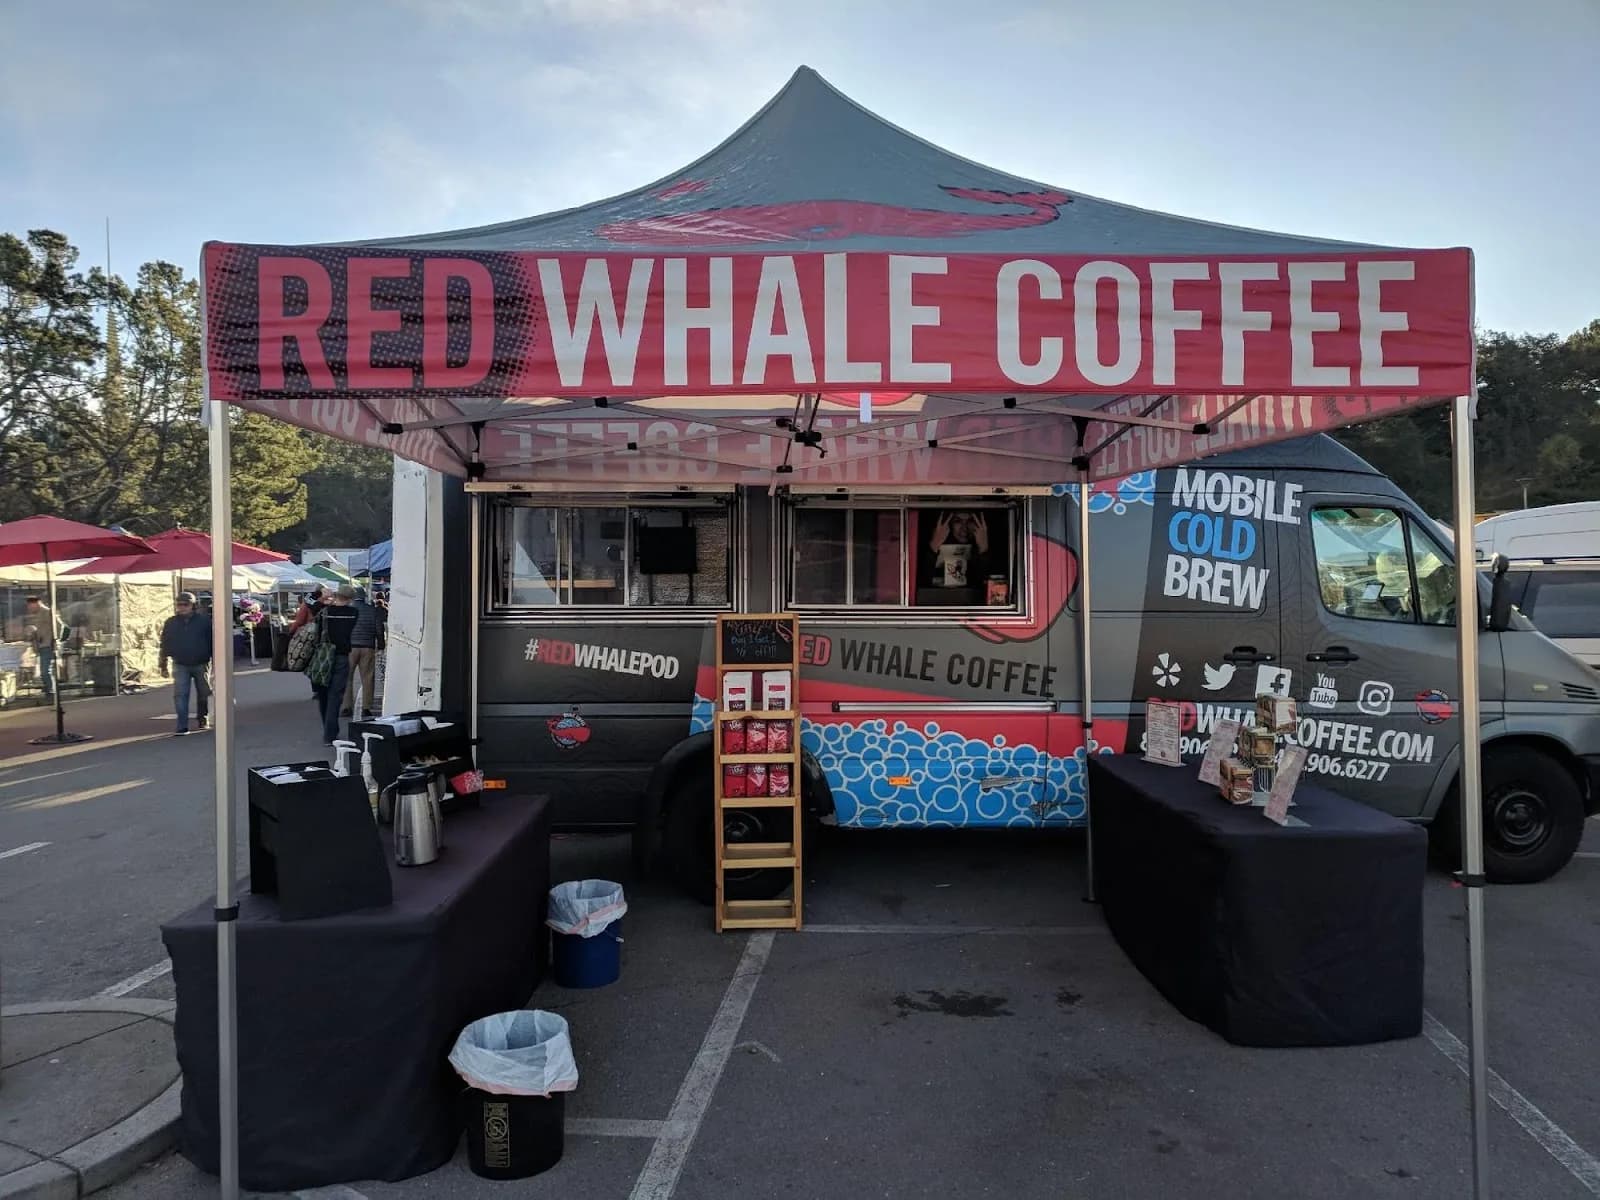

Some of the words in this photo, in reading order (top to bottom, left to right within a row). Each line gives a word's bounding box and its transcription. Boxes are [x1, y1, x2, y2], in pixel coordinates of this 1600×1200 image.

[256, 256, 495, 391] RED
[536, 252, 952, 388] WHALE
[996, 258, 1419, 387] COFFEE
[1171, 465, 1303, 525] MOBILE
[1168, 511, 1256, 561] COLD
[1163, 554, 1270, 610] BREW
[524, 638, 680, 680] #REDWHALEPOD
[799, 633, 832, 666] ED
[840, 638, 937, 682] WHALE
[946, 653, 1057, 698] COFFEE
[1317, 672, 1336, 689] You
[1312, 690, 1336, 705] Tube
